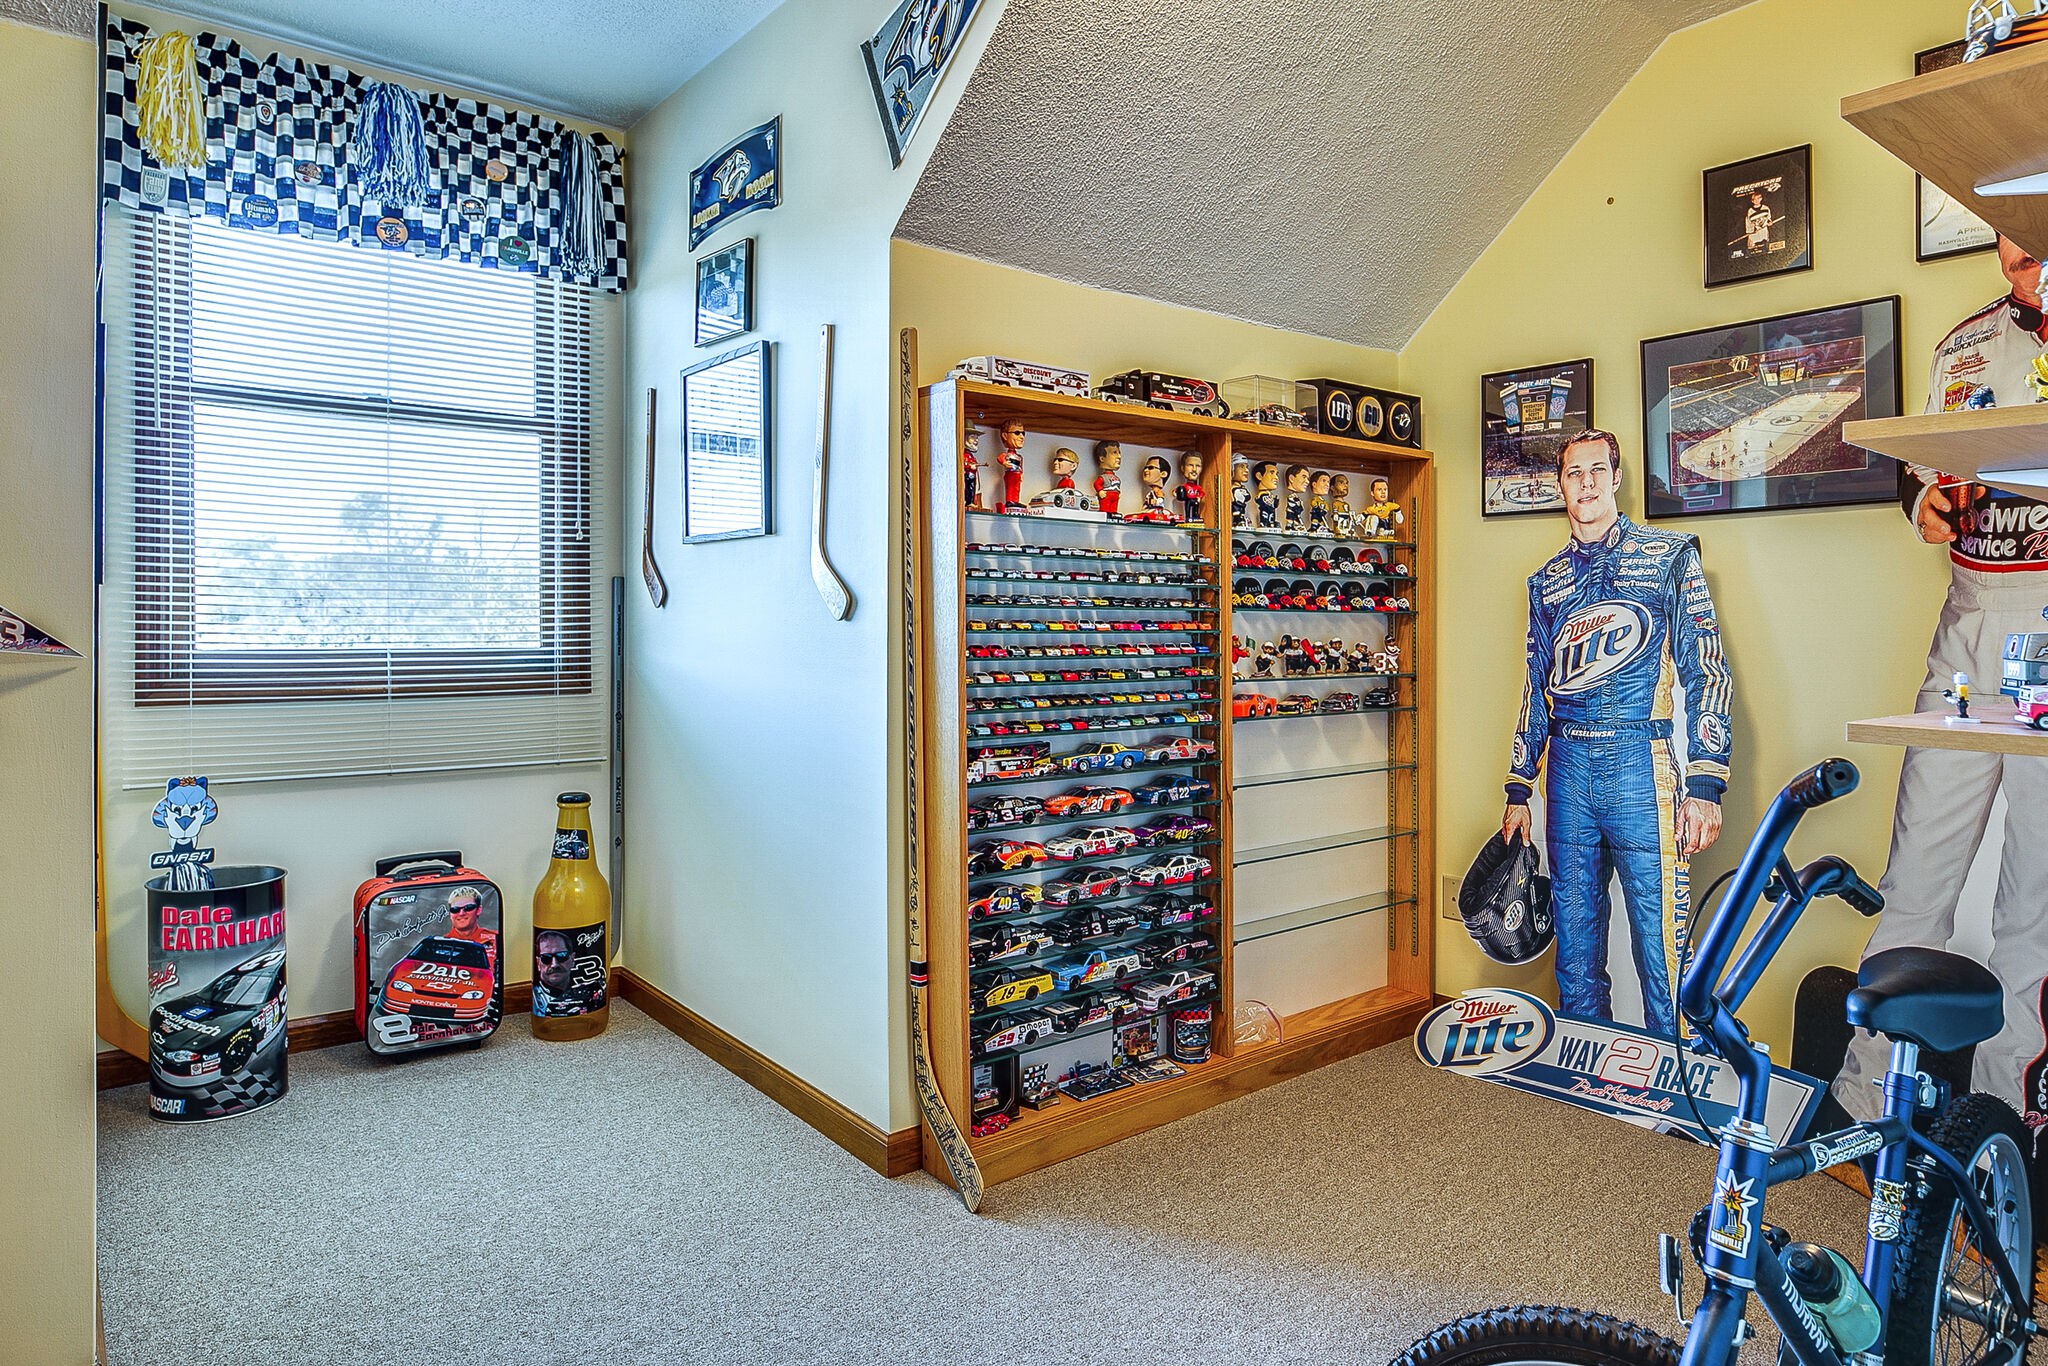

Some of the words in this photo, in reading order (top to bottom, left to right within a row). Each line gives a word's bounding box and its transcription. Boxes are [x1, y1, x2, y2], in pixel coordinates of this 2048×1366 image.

[244, 202, 276, 214] Ultimate
[247, 208, 261, 219] Fan
[1023, 367, 1052, 378] DISCOUNT
[1183, 387, 1192, 396] 3
[1275, 410, 1286, 421] 3
[1331, 400, 1351, 419] LET'S
[1364, 404, 1381, 428] GO!
[1961, 535, 2017, 558] Service
[1542, 567, 1573, 587] DODGE
[1565, 612, 1616, 642] Miller
[1558, 622, 1633, 680] Lite
[1373, 652, 1387, 671] 3
[1570, 729, 1616, 738] KESELOWSKI
[1177, 746, 1190, 758] 3
[1105, 753, 1116, 767] 2
[1179, 786, 1190, 799] 22
[1090, 798, 1104, 811] 20
[1000, 808, 1015, 821] 3
[1175, 828, 1189, 840] 40
[1094, 839, 1107, 851] 29
[152, 850, 212, 866] GNASH
[1173, 866, 1186, 879] 48
[389, 894, 417, 906] NASCAR
[1673, 866, 1691, 924] TASTE
[997, 896, 1012, 911] 40
[162, 905, 233, 925] Dale
[1106, 915, 1136, 925] Goodwrench
[1172, 909, 1181, 923] 7
[1091, 922, 1102, 935] 3
[1004, 939, 1012, 954] 1
[406, 973, 461, 984] EARNHARDT
[411, 961, 472, 981] Dale
[571, 954, 607, 988] 3
[1000, 985, 1016, 1001] 19
[411, 998, 434, 1007] MONTE
[434, 1001, 458, 1009] CARLO
[1088, 1006, 1106, 1021] 29
[1452, 999, 1518, 1024] Miller
[155, 1005, 222, 1037] Goodwrench
[162, 1019, 185, 1032] Service
[409, 1022, 436, 1035] Dale
[372, 1013, 419, 1046] 8
[997, 1032, 1015, 1047] 29
[1440, 1017, 1535, 1069] Lite
[1557, 1035, 1609, 1075] WAY
[1598, 1037, 1660, 1090] 2
[1656, 1060, 1721, 1100] RACE
[1834, 1129, 1870, 1149] NASHVILLE
[1831, 1137, 1881, 1163] PREDATORS
[1711, 1230, 1743, 1251] NASHVILLE
[1781, 1278, 1830, 1354] MURRAY
